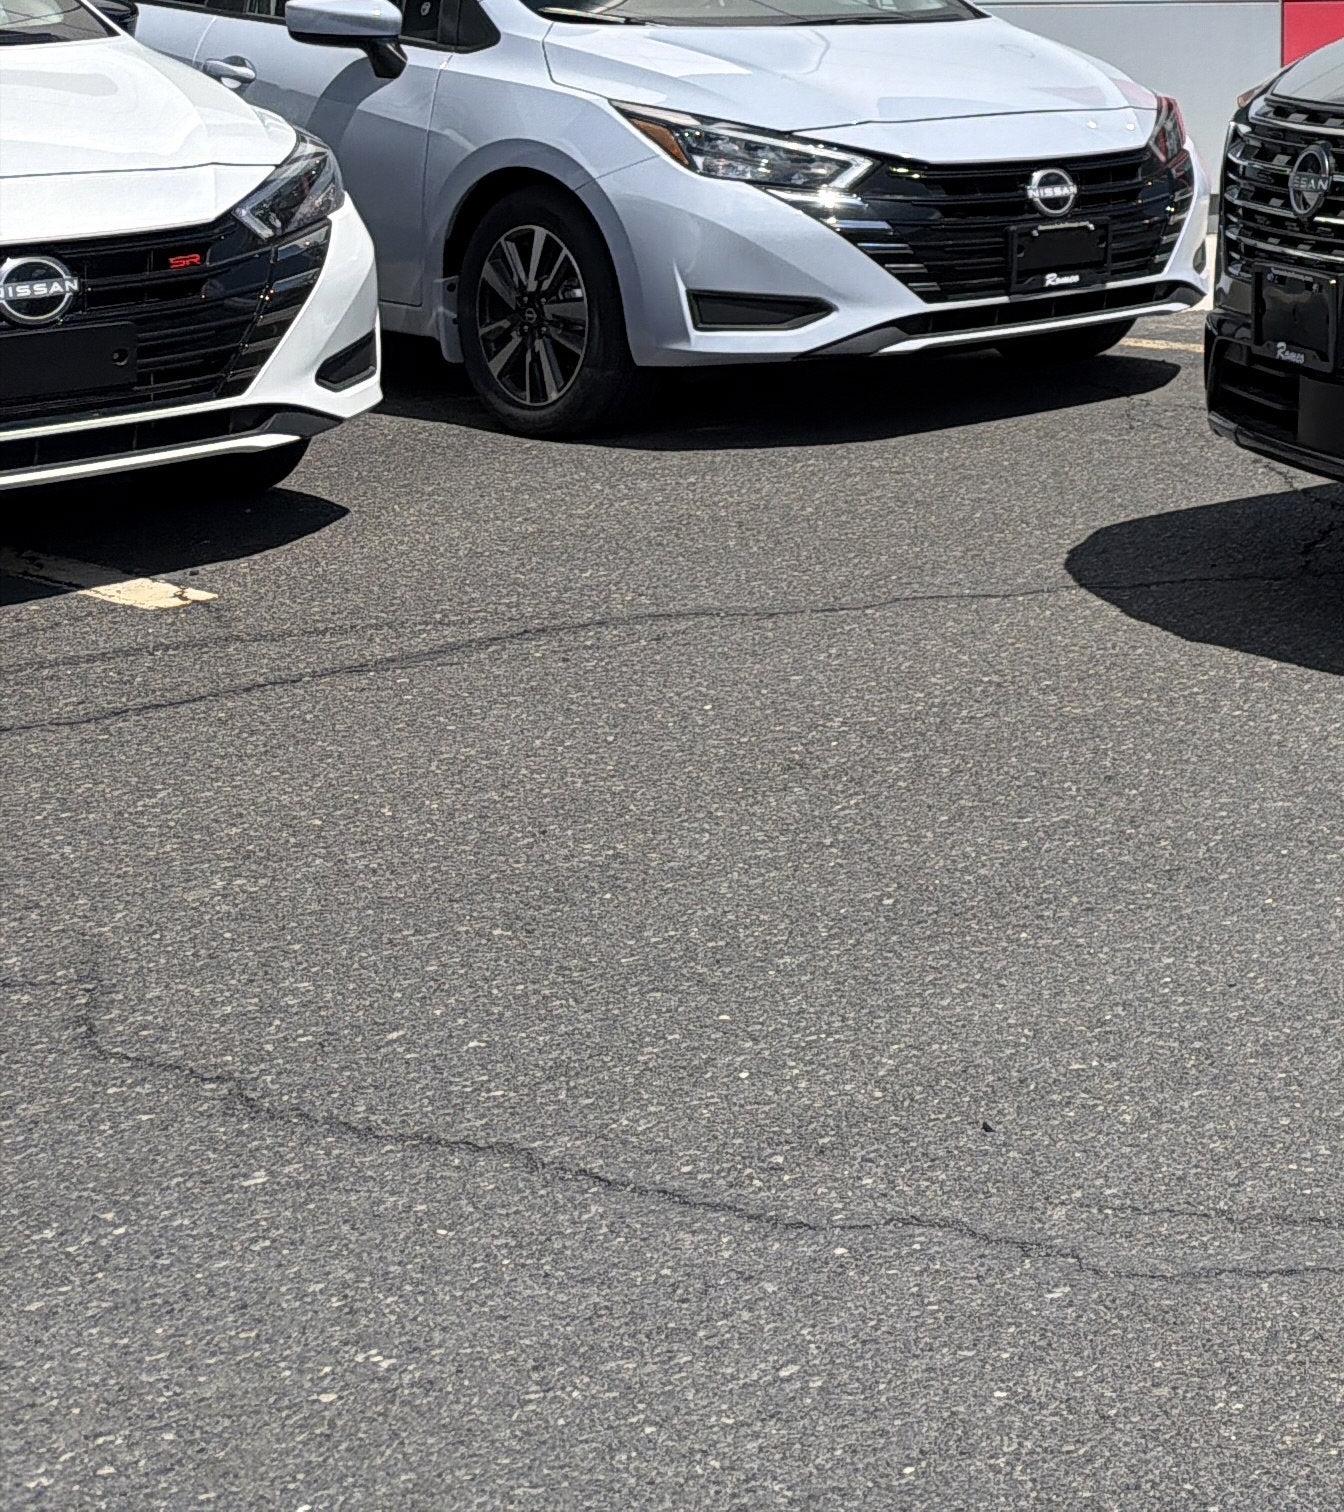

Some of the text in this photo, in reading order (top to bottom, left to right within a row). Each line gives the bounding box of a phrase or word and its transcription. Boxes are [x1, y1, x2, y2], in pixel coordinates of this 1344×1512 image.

[1028, 186, 1077, 198] NISSAN
[168, 253, 201, 269] SR
[1044, 272, 1080, 287] Romeo
[1275, 341, 1305, 364] Romeo
